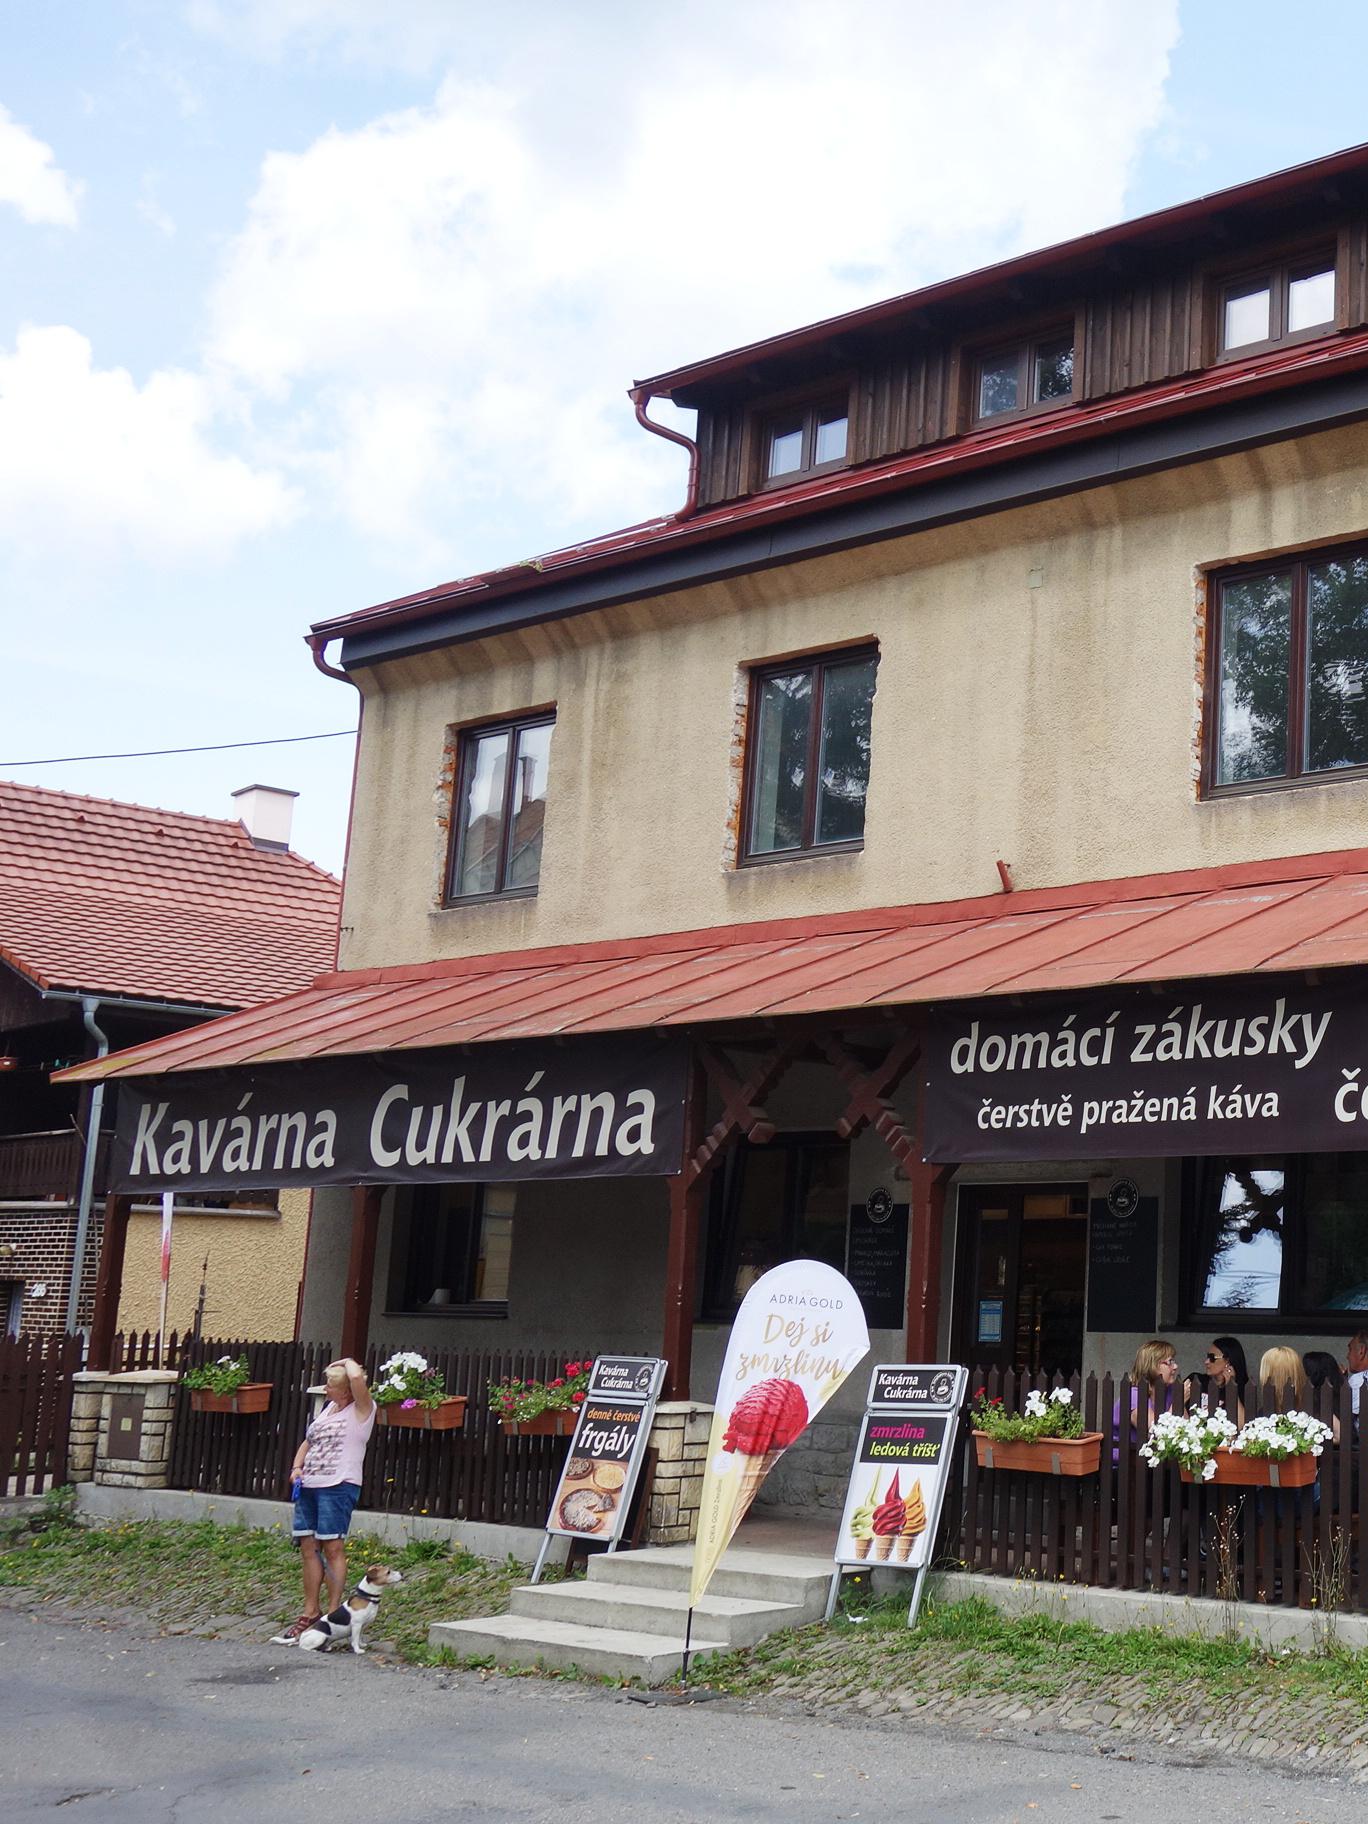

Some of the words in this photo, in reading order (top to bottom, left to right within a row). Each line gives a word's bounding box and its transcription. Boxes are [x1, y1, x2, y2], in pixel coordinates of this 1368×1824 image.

[950, 1011, 1121, 1074] domácí
[1130, 997, 1333, 1069] zákusky
[977, 1094, 1072, 1130] čerstvě
[1080, 1087, 1197, 1133] pražená
[1207, 1084, 1279, 1119] káva
[128, 1092, 335, 1176] Kavárna
[369, 1071, 656, 1168] Cukrárna
[763, 1313, 809, 1347] Dej
[810, 1321, 834, 1347] si
[599, 1364, 628, 1376] Kavárna
[736, 1350, 846, 1381] zmrzlinu
[601, 1377, 633, 1389] Cukrárna
[878, 1373, 918, 1385] Kavárna
[884, 1386, 927, 1398] Cukrárna
[587, 1408, 612, 1420] denně
[612, 1410, 641, 1423] čerstvé
[870, 1424, 925, 1438] zmrzlina
[578, 1422, 636, 1459] frgály
[870, 1441, 909, 1456] ledová
